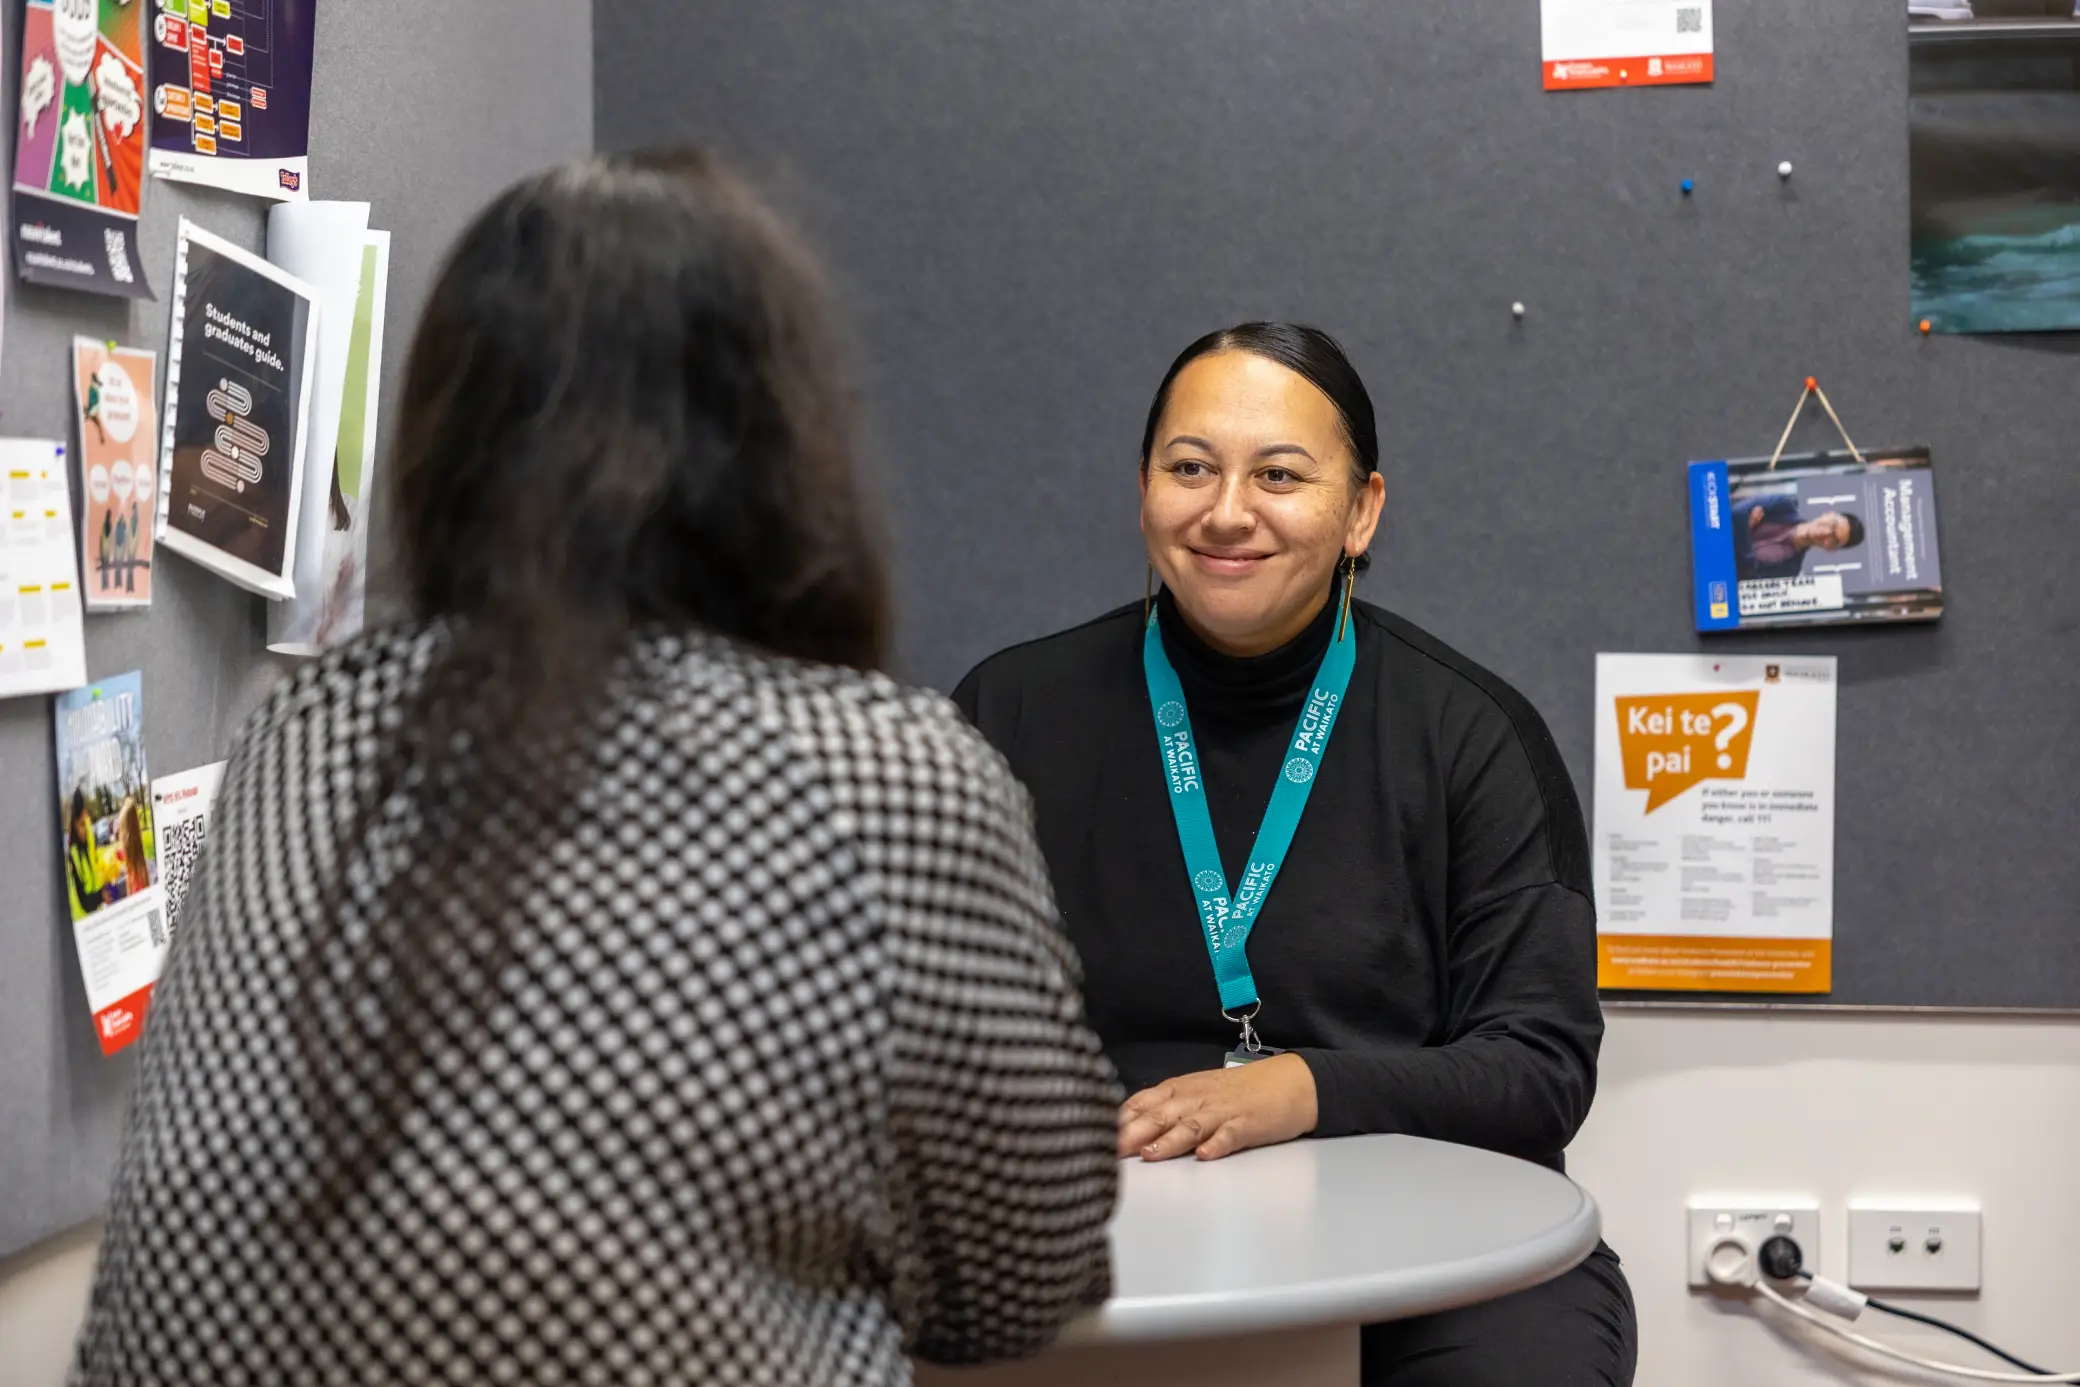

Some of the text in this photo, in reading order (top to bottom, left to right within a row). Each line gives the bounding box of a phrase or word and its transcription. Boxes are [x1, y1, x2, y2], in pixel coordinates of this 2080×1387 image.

[205, 322, 284, 372] graduates guide.
[206, 302, 271, 347] Students and
[1883, 486, 1902, 575] Accountant
[1898, 479, 1918, 580] Management
[1293, 687, 1329, 752] PACIFIC
[1310, 694, 1339, 755] AT WAIKATO
[1628, 706, 1673, 735] Kei
[1680, 709, 1712, 736] te
[1163, 735, 1183, 794] AT WAIKATO
[1174, 730, 1199, 792] PACIFIC
[1646, 745, 1691, 782] pai
[1202, 900, 1213, 912] AT
[1231, 861, 1266, 919] PACIFIC
[1246, 863, 1275, 918] AT WAIKATO
